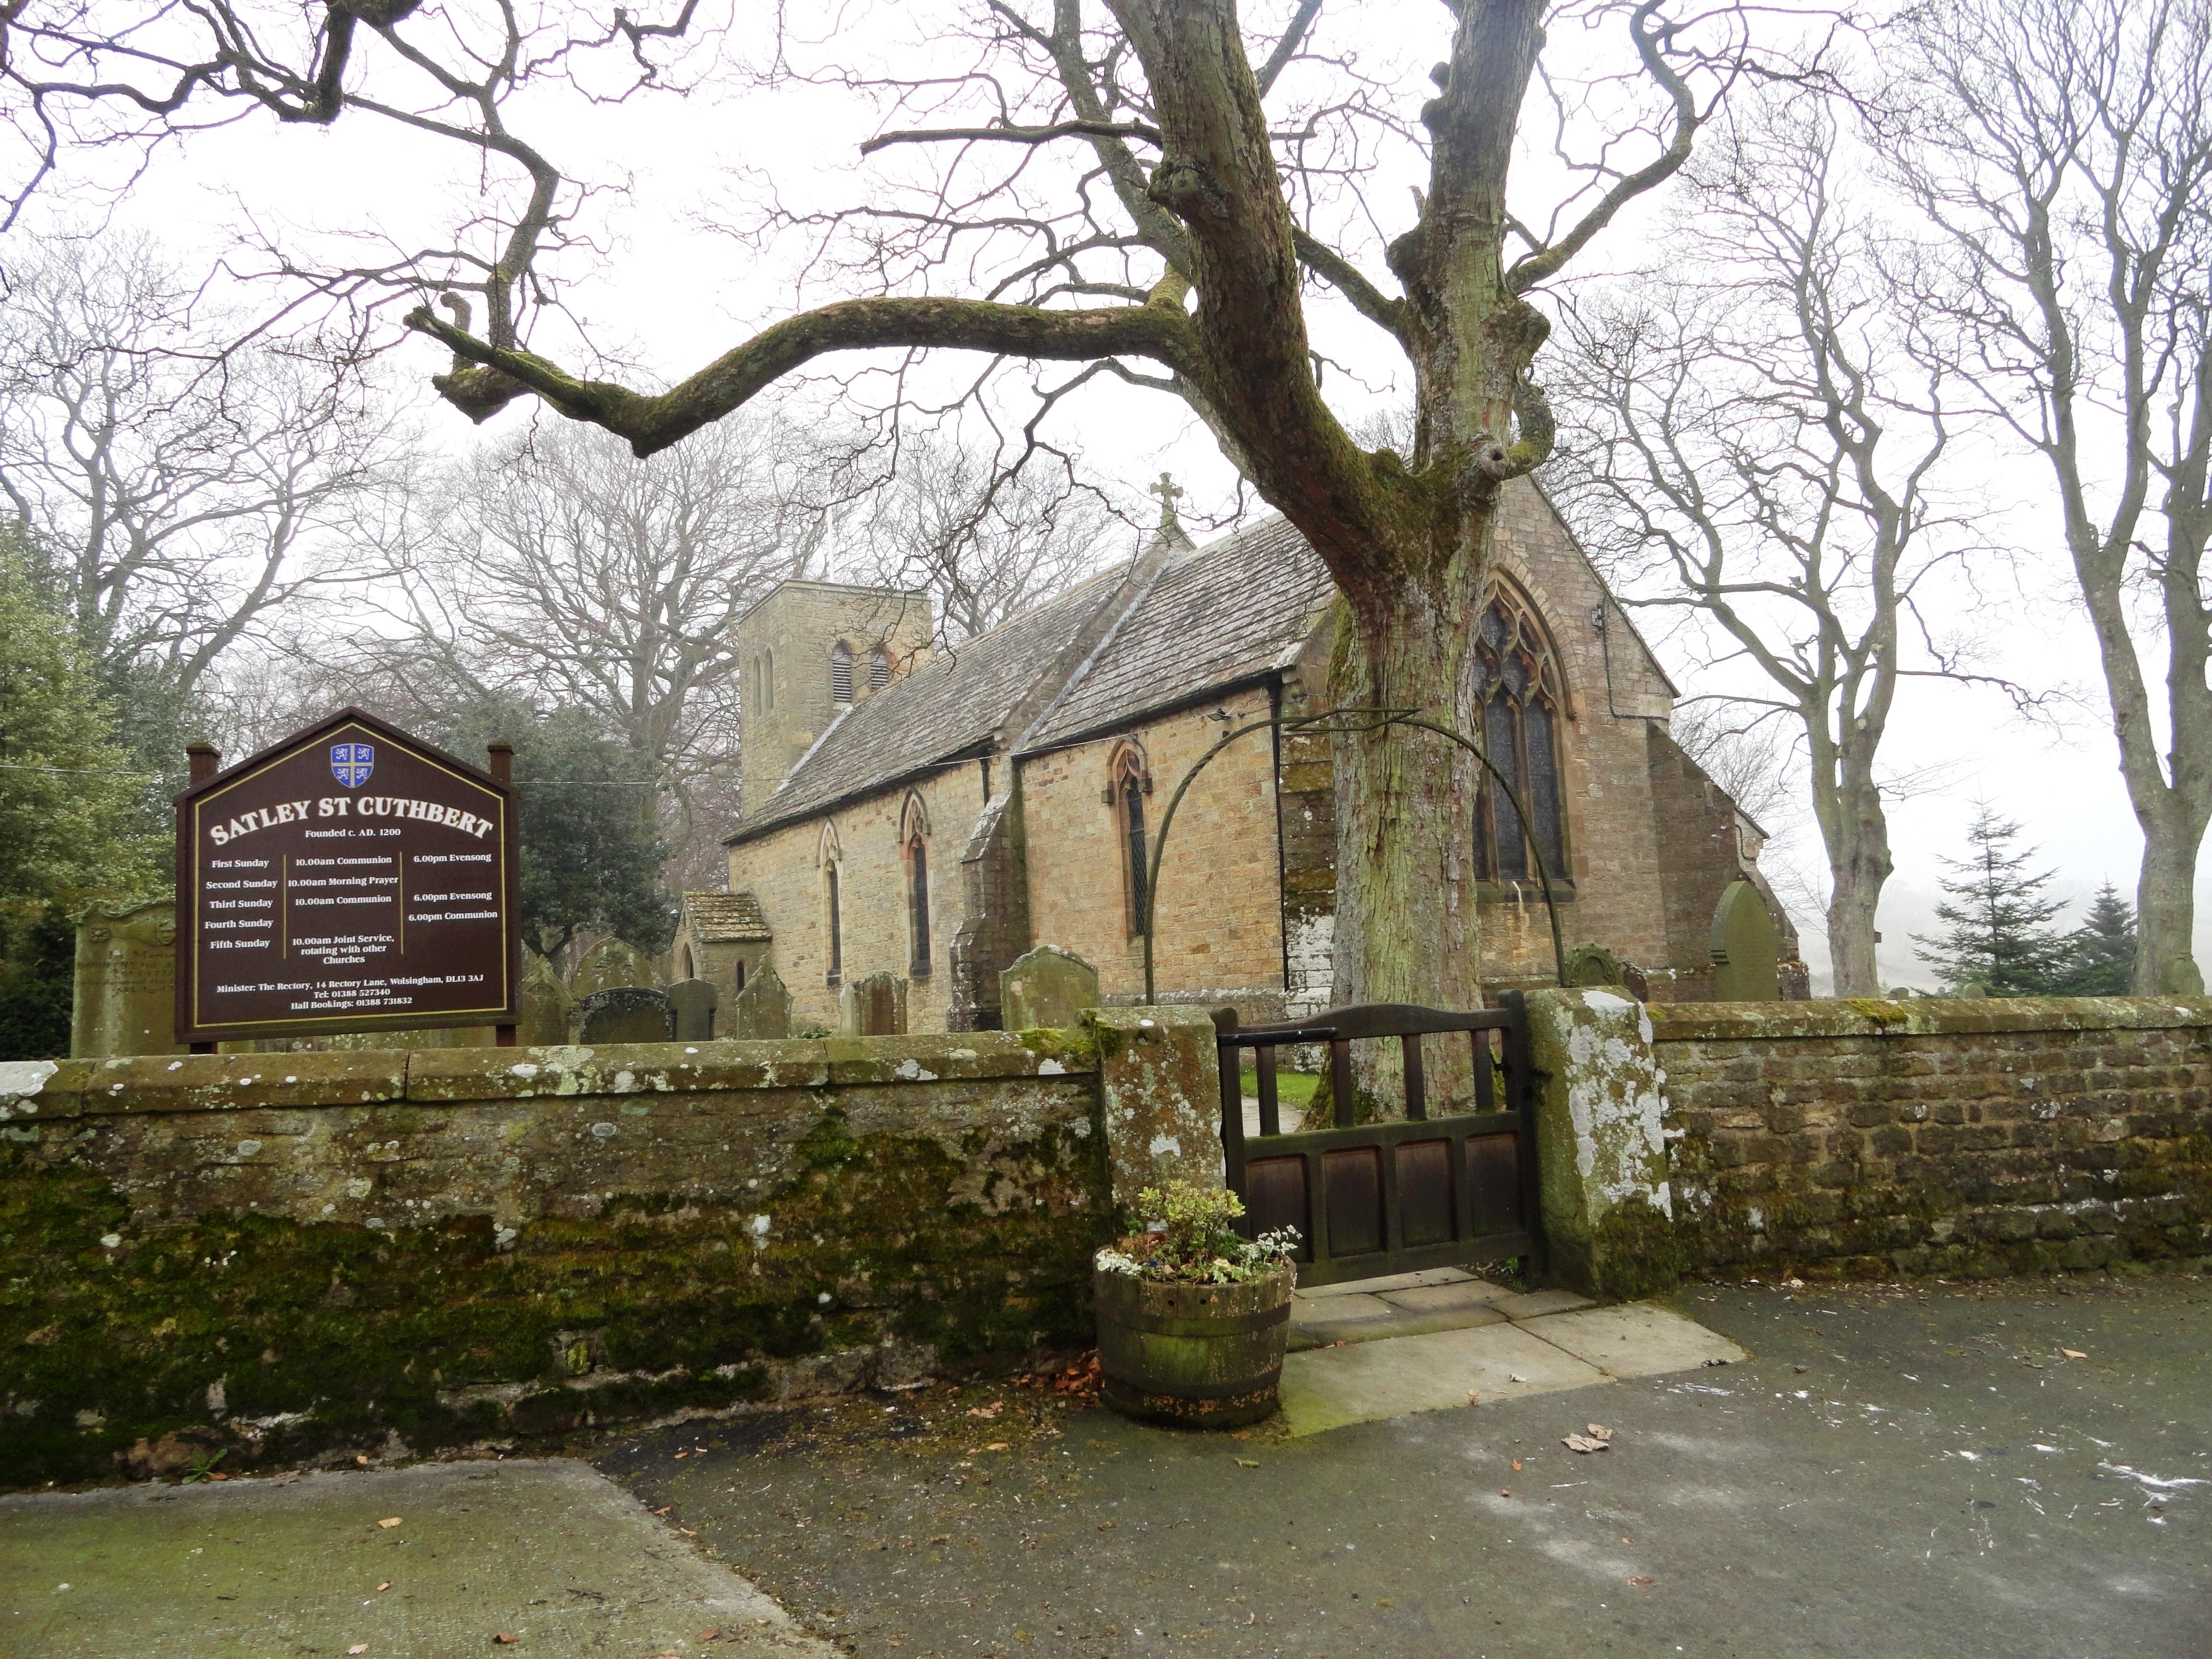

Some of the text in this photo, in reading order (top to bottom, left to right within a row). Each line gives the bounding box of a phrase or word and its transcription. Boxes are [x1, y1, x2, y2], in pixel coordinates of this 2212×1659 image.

[210, 796, 493, 846] SATLEY ST CUTHBERT
[305, 829, 346, 838] Founded
[358, 829, 376, 837] AD.
[212, 858, 270, 868] First Sunday
[296, 855, 392, 866] 10.00am Communion
[413, 854, 492, 864] 6.00pm Evensong
[205, 879, 278, 890] Second Sunday
[288, 877, 399, 887] 10.00am Morning Prayer
[295, 894, 392, 906] 10.00am Communion
[413, 892, 493, 902] 6.00pm Evensong
[209, 899, 274, 909] Third Sunday
[408, 910, 498, 922] 6.00pm Communion
[204, 918, 274, 929] Fourth Sunday
[210, 938, 271, 949] Fifth Sunday
[292, 934, 395, 946] 10.00am Joint Service,
[301, 944, 387, 956] rotating with other
[323, 955, 365, 964] Churches
[216, 984, 256, 993] Minister:
[258, 983, 275, 991] The
[328, 980, 361, 988] Rectory
[389, 976, 444, 986] Wolsingham,
[313, 990, 329, 999] Tel:
[359, 988, 391, 997] 527340
[291, 997, 412, 1010] Hall Bookings: 01388 731832
